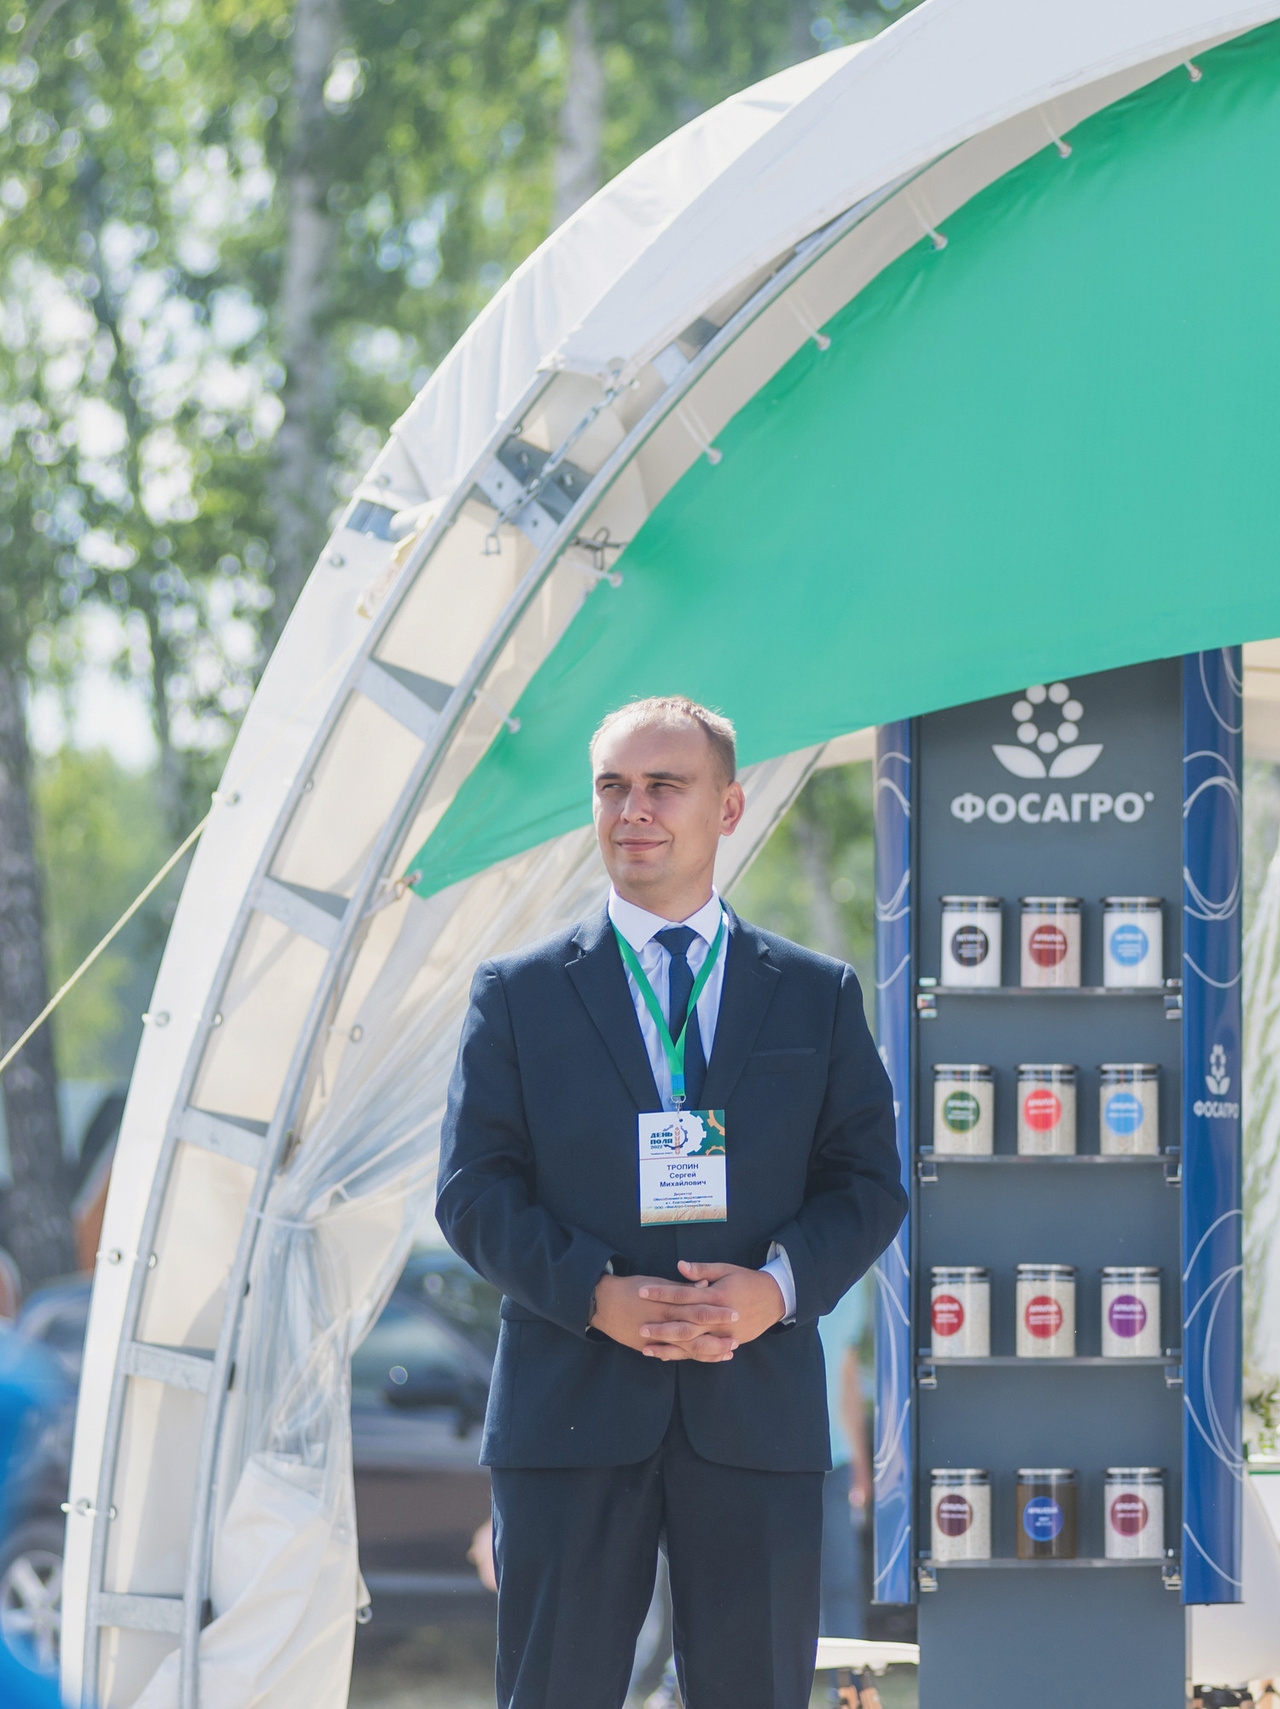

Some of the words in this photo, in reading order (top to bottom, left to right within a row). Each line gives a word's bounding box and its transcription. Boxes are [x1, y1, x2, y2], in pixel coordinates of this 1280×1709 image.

[950, 792, 1145, 824] ФОСАГРО
[667, 1163, 699, 1171] ТРОПИН
[669, 1172, 697, 1180] Сергей
[659, 1180, 707, 1188] Михайлович
